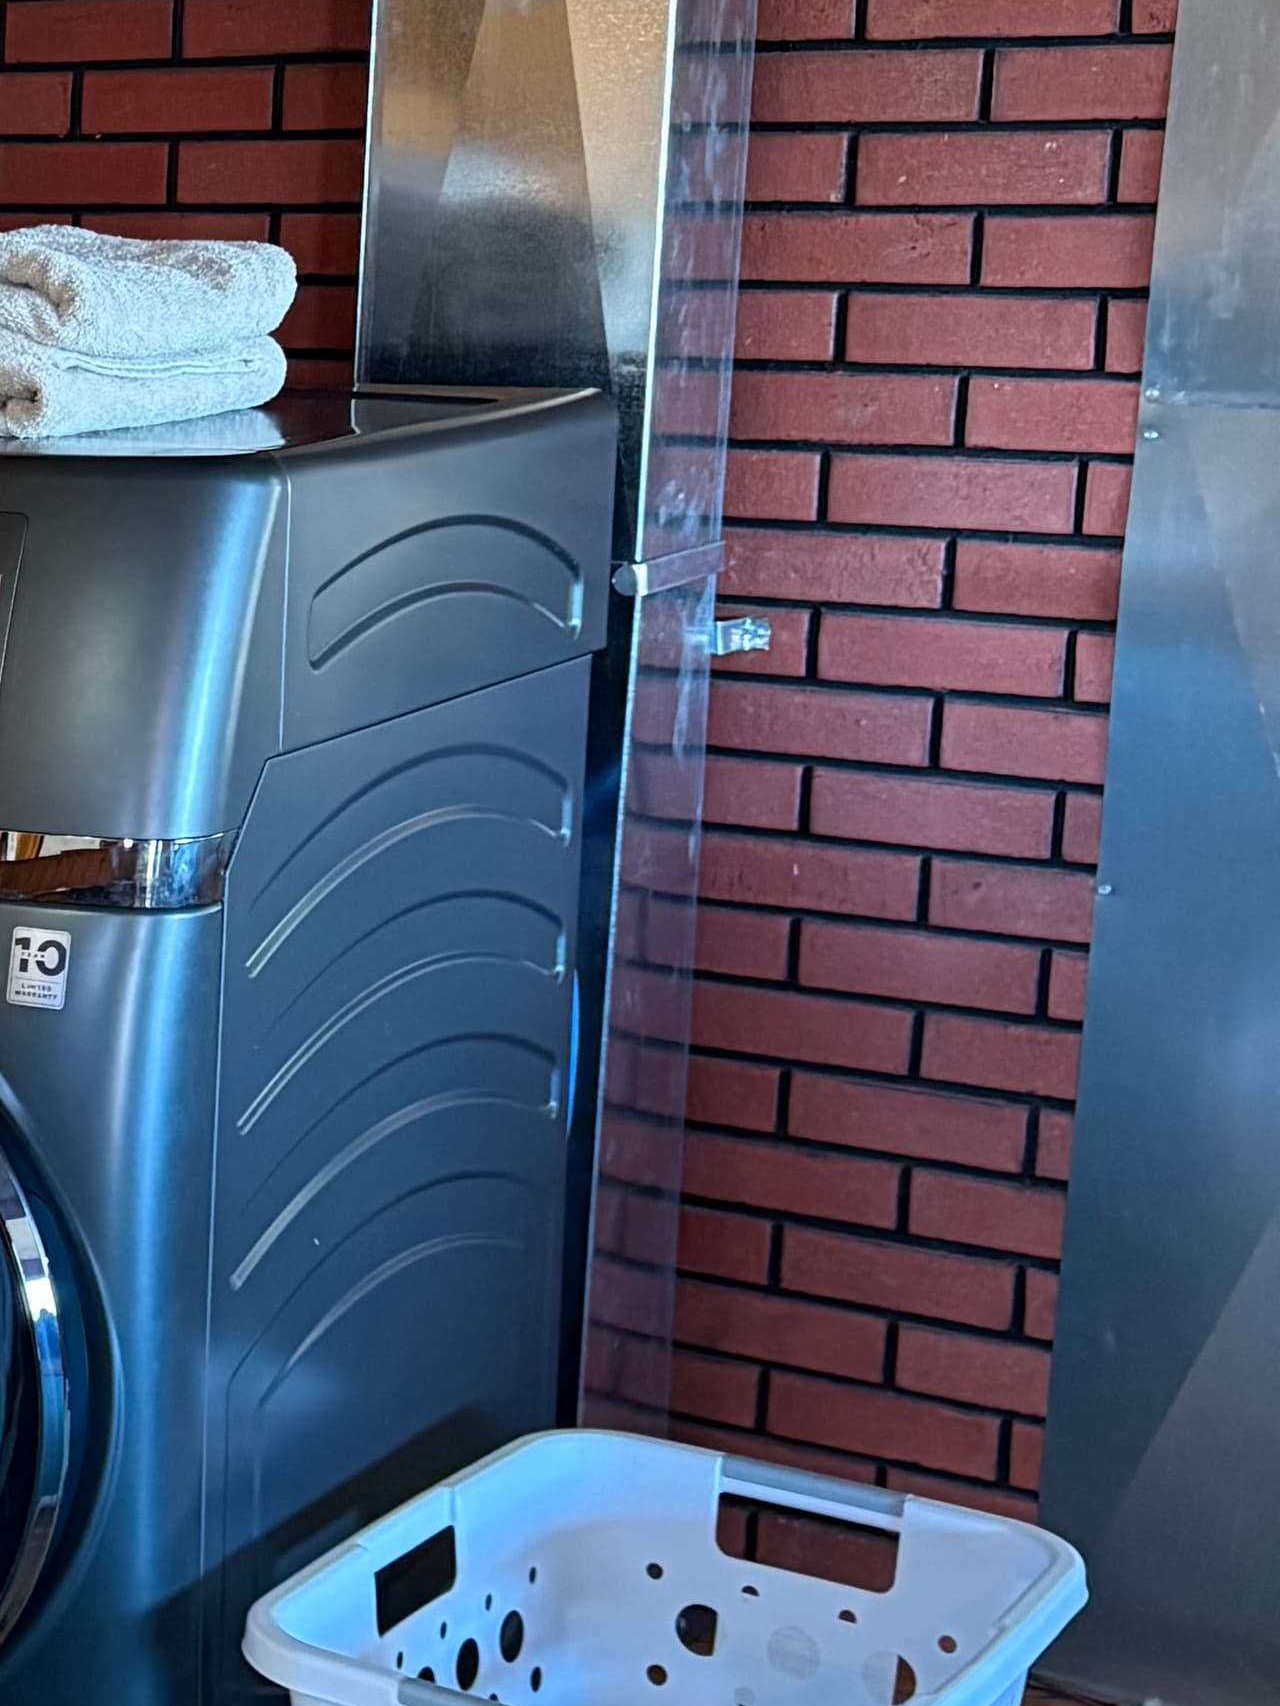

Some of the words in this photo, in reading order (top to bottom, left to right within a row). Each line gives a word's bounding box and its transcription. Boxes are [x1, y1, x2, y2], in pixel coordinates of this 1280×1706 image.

[15, 937, 67, 977] 10
[22, 983, 52, 992] LIMITED
[15, 990, 57, 1000] WARRANTY
